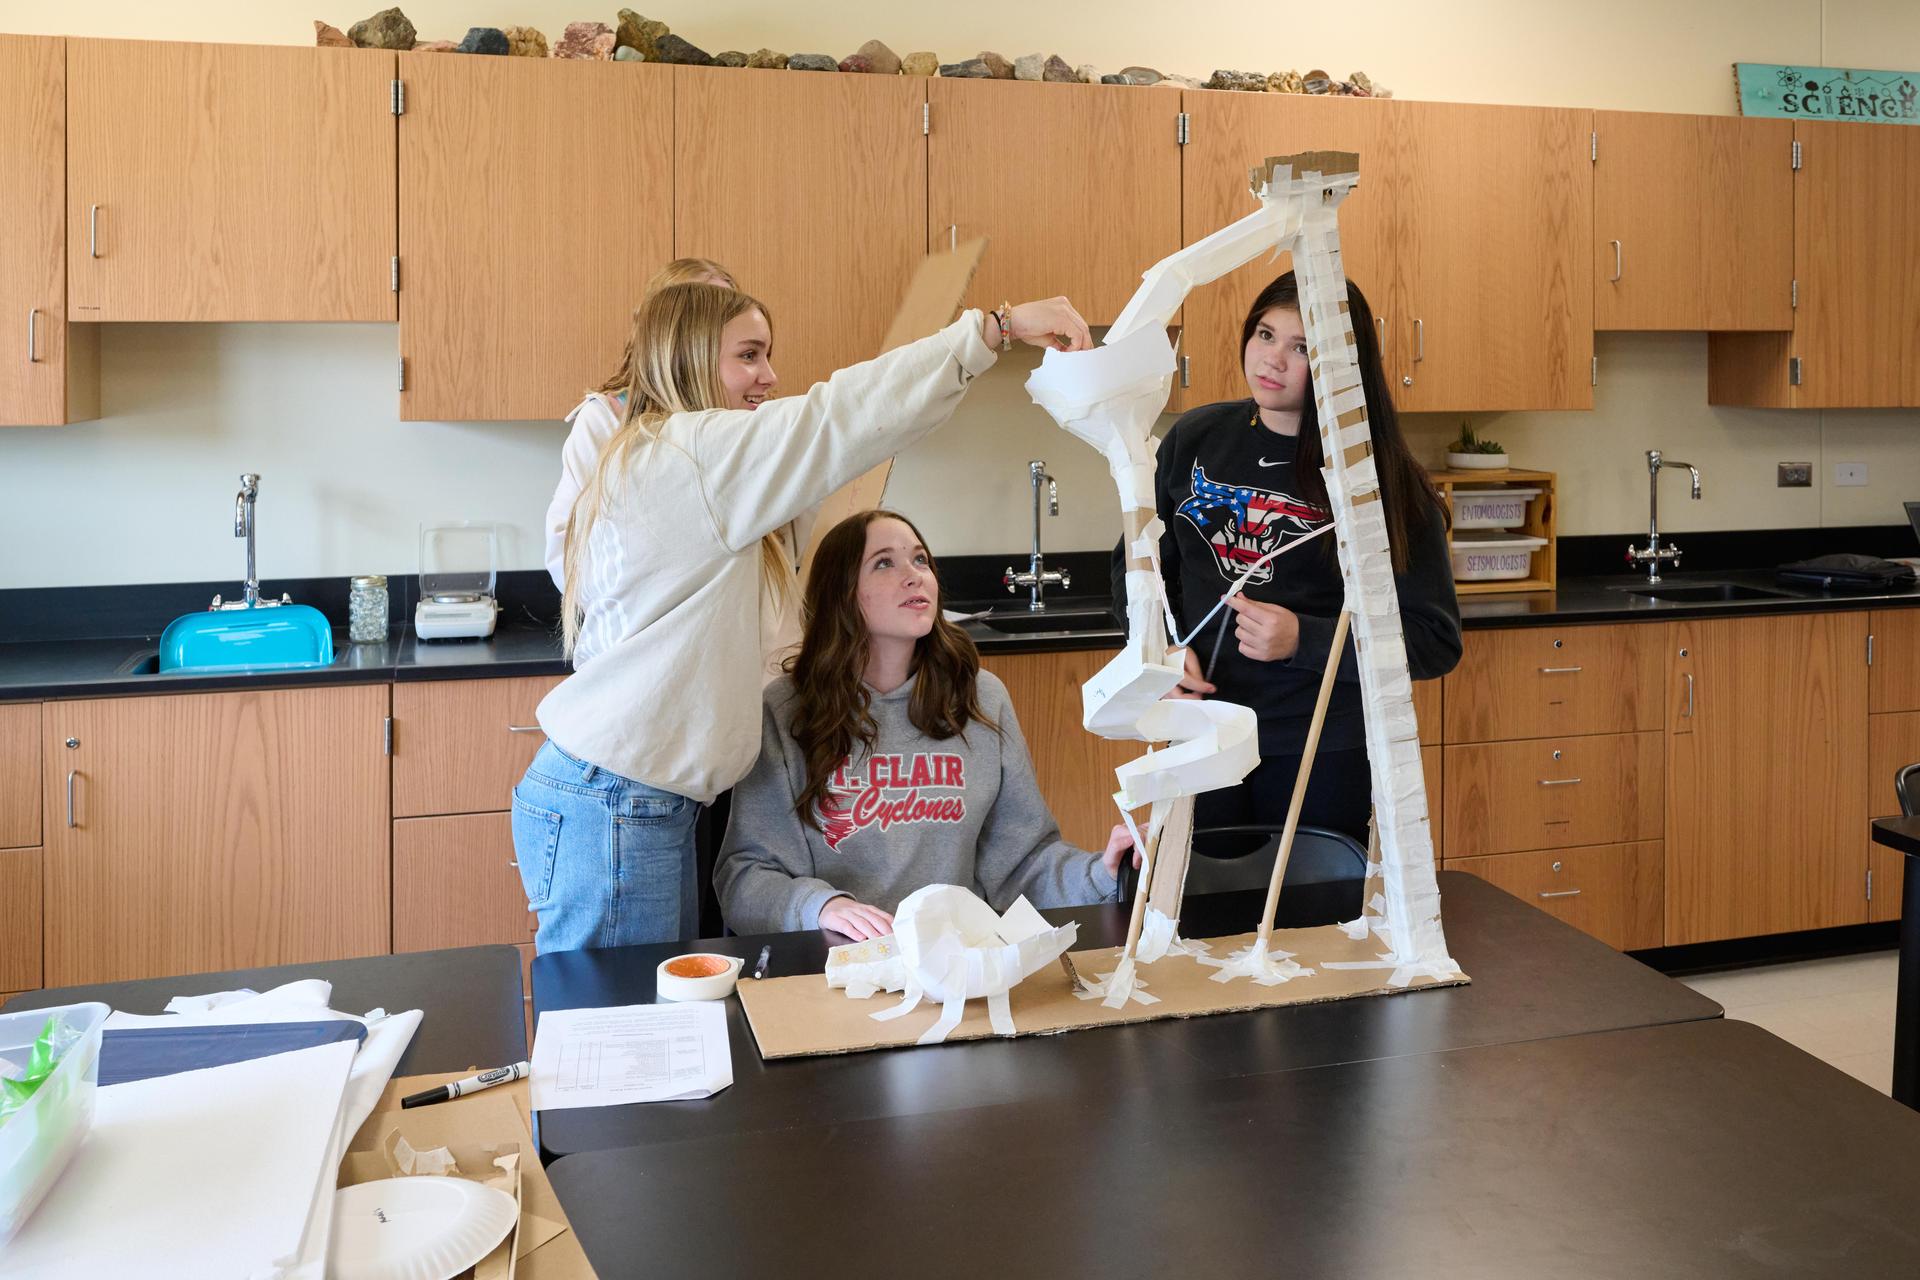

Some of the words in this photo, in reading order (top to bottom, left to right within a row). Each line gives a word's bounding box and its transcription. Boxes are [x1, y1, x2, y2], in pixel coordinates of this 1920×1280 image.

[1782, 93, 1919, 119] SCIENCE
[1462, 503, 1522, 520] ENTOMOLOGISTS
[1467, 553, 1528, 572] SEISMOLOGISTS
[829, 754, 862, 788] T.
[868, 753, 966, 789] CLAIR
[851, 785, 966, 832] Cyclones
